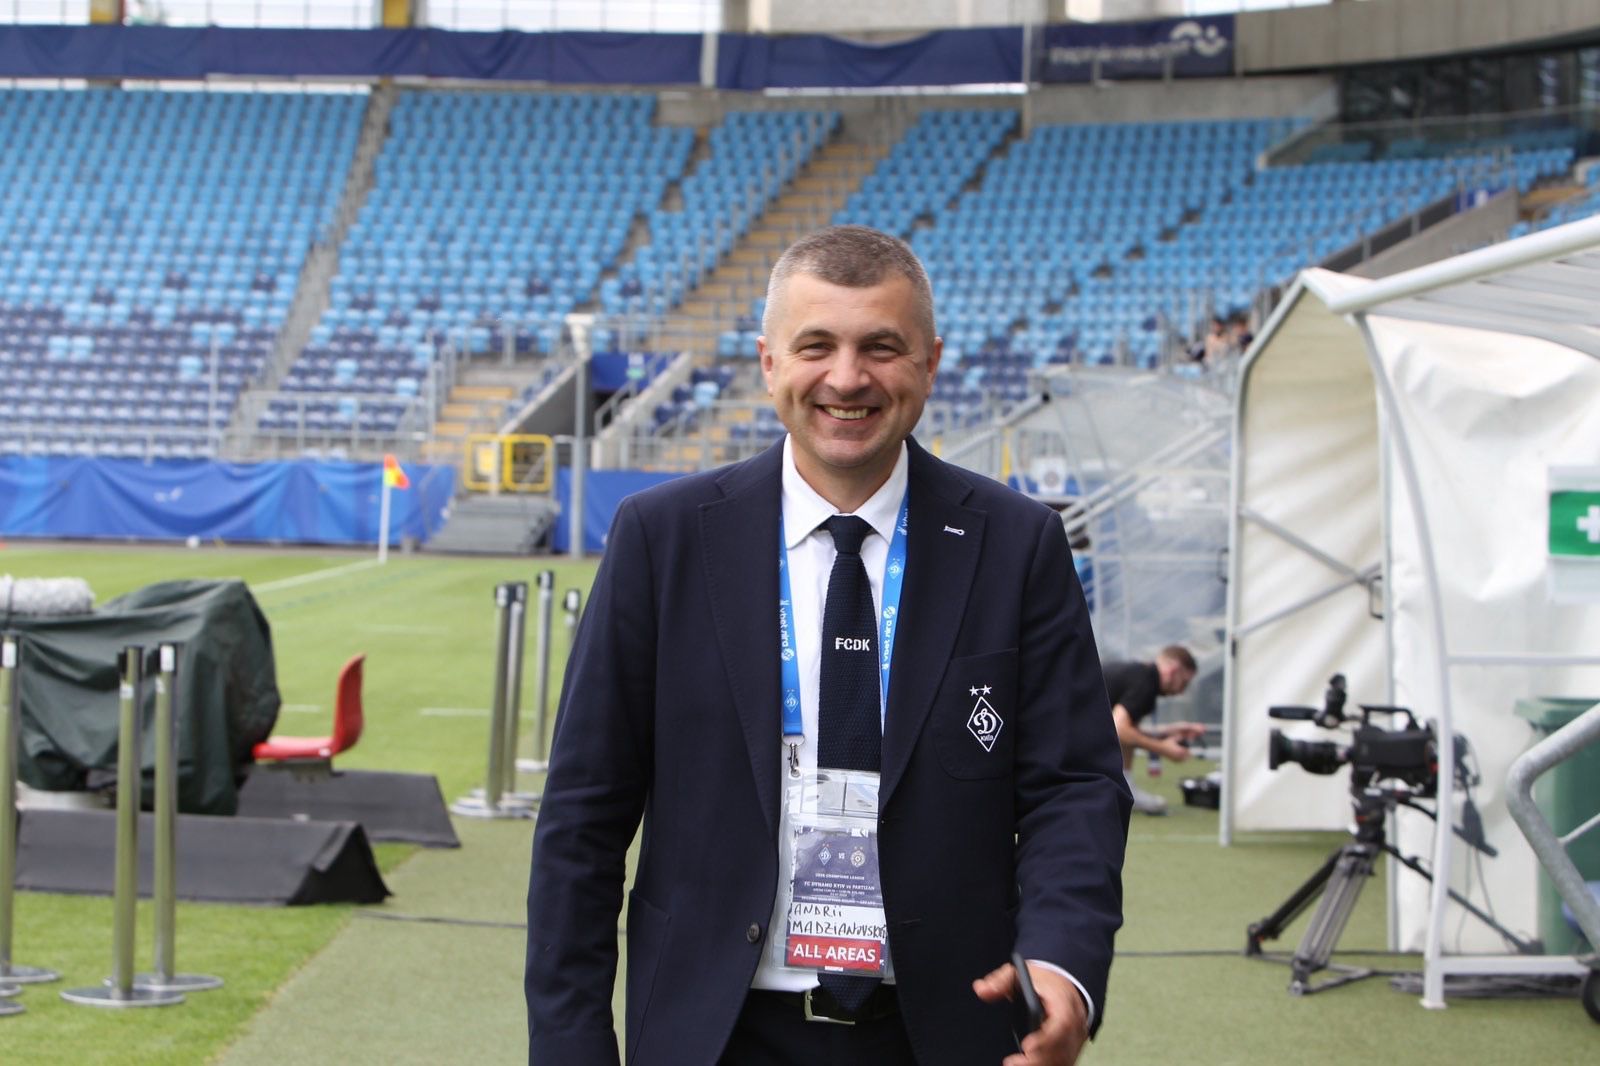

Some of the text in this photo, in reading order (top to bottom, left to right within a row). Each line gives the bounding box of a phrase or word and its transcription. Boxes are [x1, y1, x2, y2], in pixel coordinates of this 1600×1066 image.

[835, 637, 870, 651] FCDK
[852, 883, 875, 891] PARTIZAN
[793, 943, 876, 962] ALL AREAS
